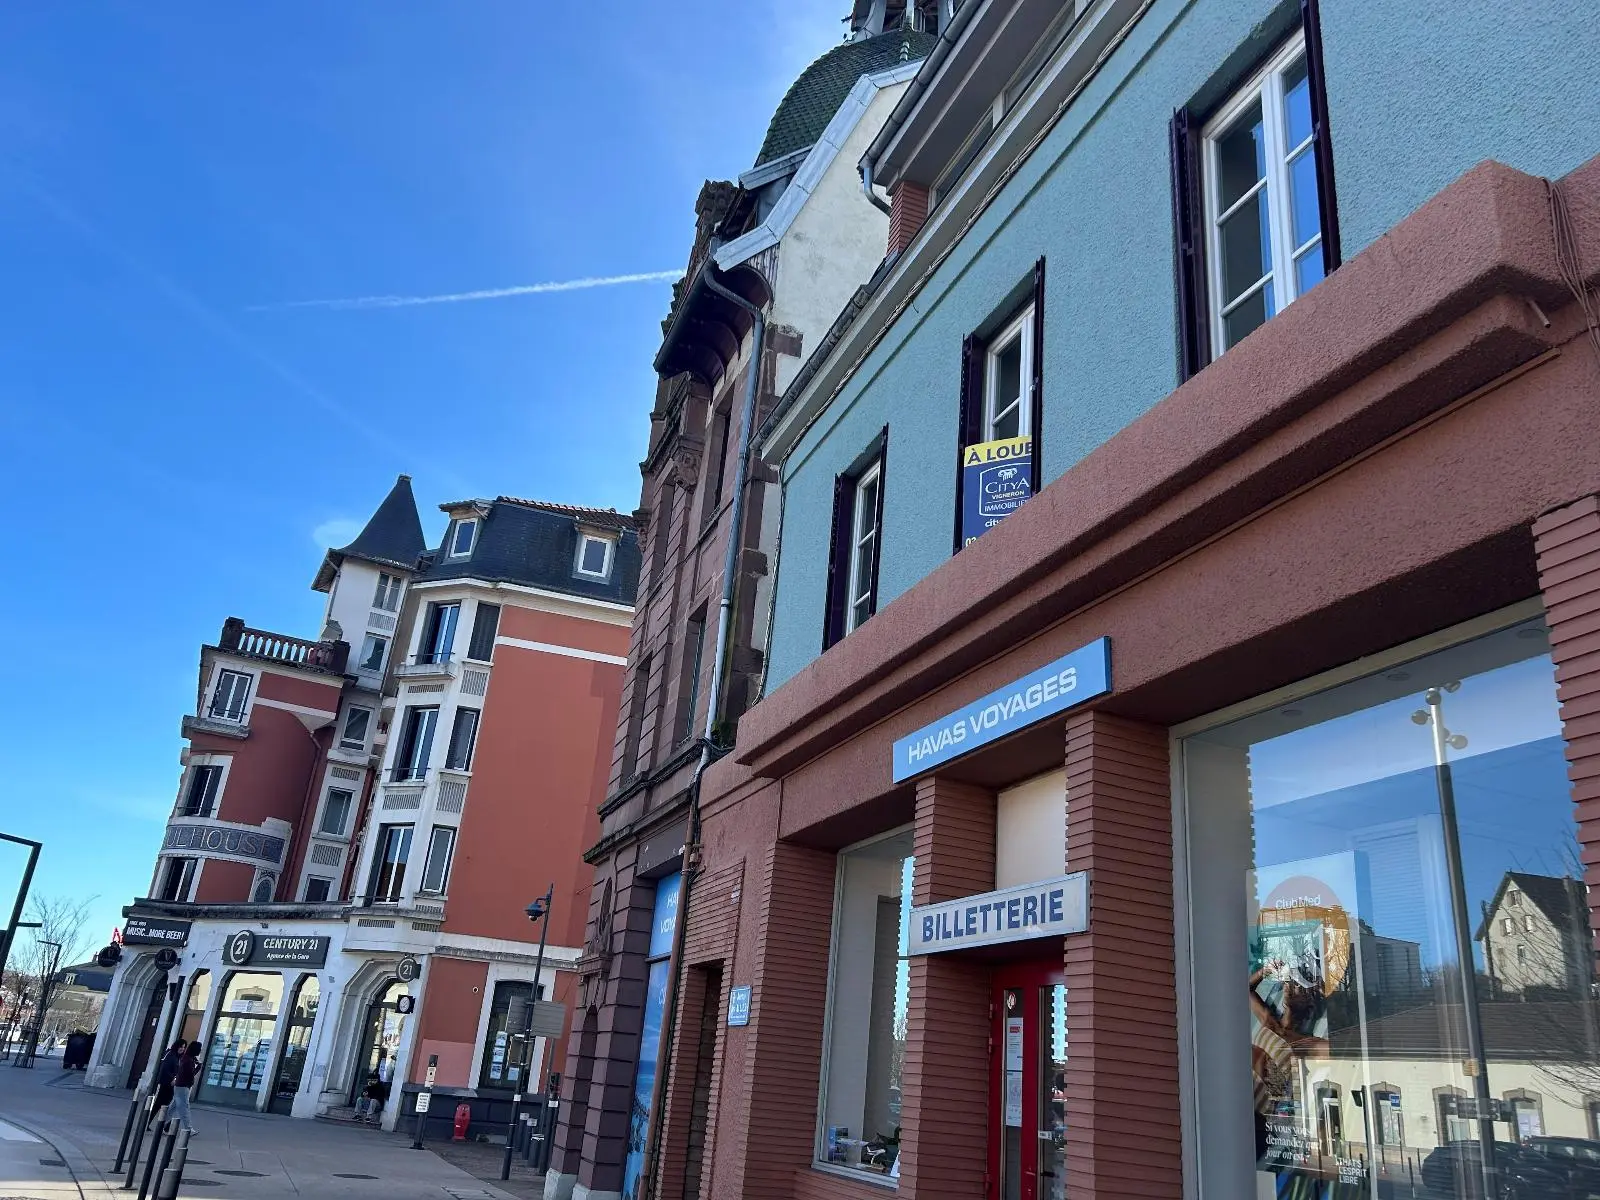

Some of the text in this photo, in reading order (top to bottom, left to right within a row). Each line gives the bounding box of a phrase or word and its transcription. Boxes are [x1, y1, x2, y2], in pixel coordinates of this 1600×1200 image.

[967, 441, 1032, 465] À LOUE
[992, 490, 1025, 500] VIGNERON
[909, 667, 1077, 764] HAVAS VOYAGES
[1275, 894, 1321, 910] Club Med
[922, 889, 1064, 943] BILLETTERIE
[165, 930, 185, 940] BEER!
[263, 938, 319, 950] CENTURY 21
[266, 952, 285, 960] Agence
[402, 965, 413, 976] 21
[1265, 1121, 1312, 1138] Si vous vous
[1265, 1134, 1304, 1149] demandez
[1265, 1147, 1282, 1160] jour
[1339, 1175, 1359, 1185] LIBRE
